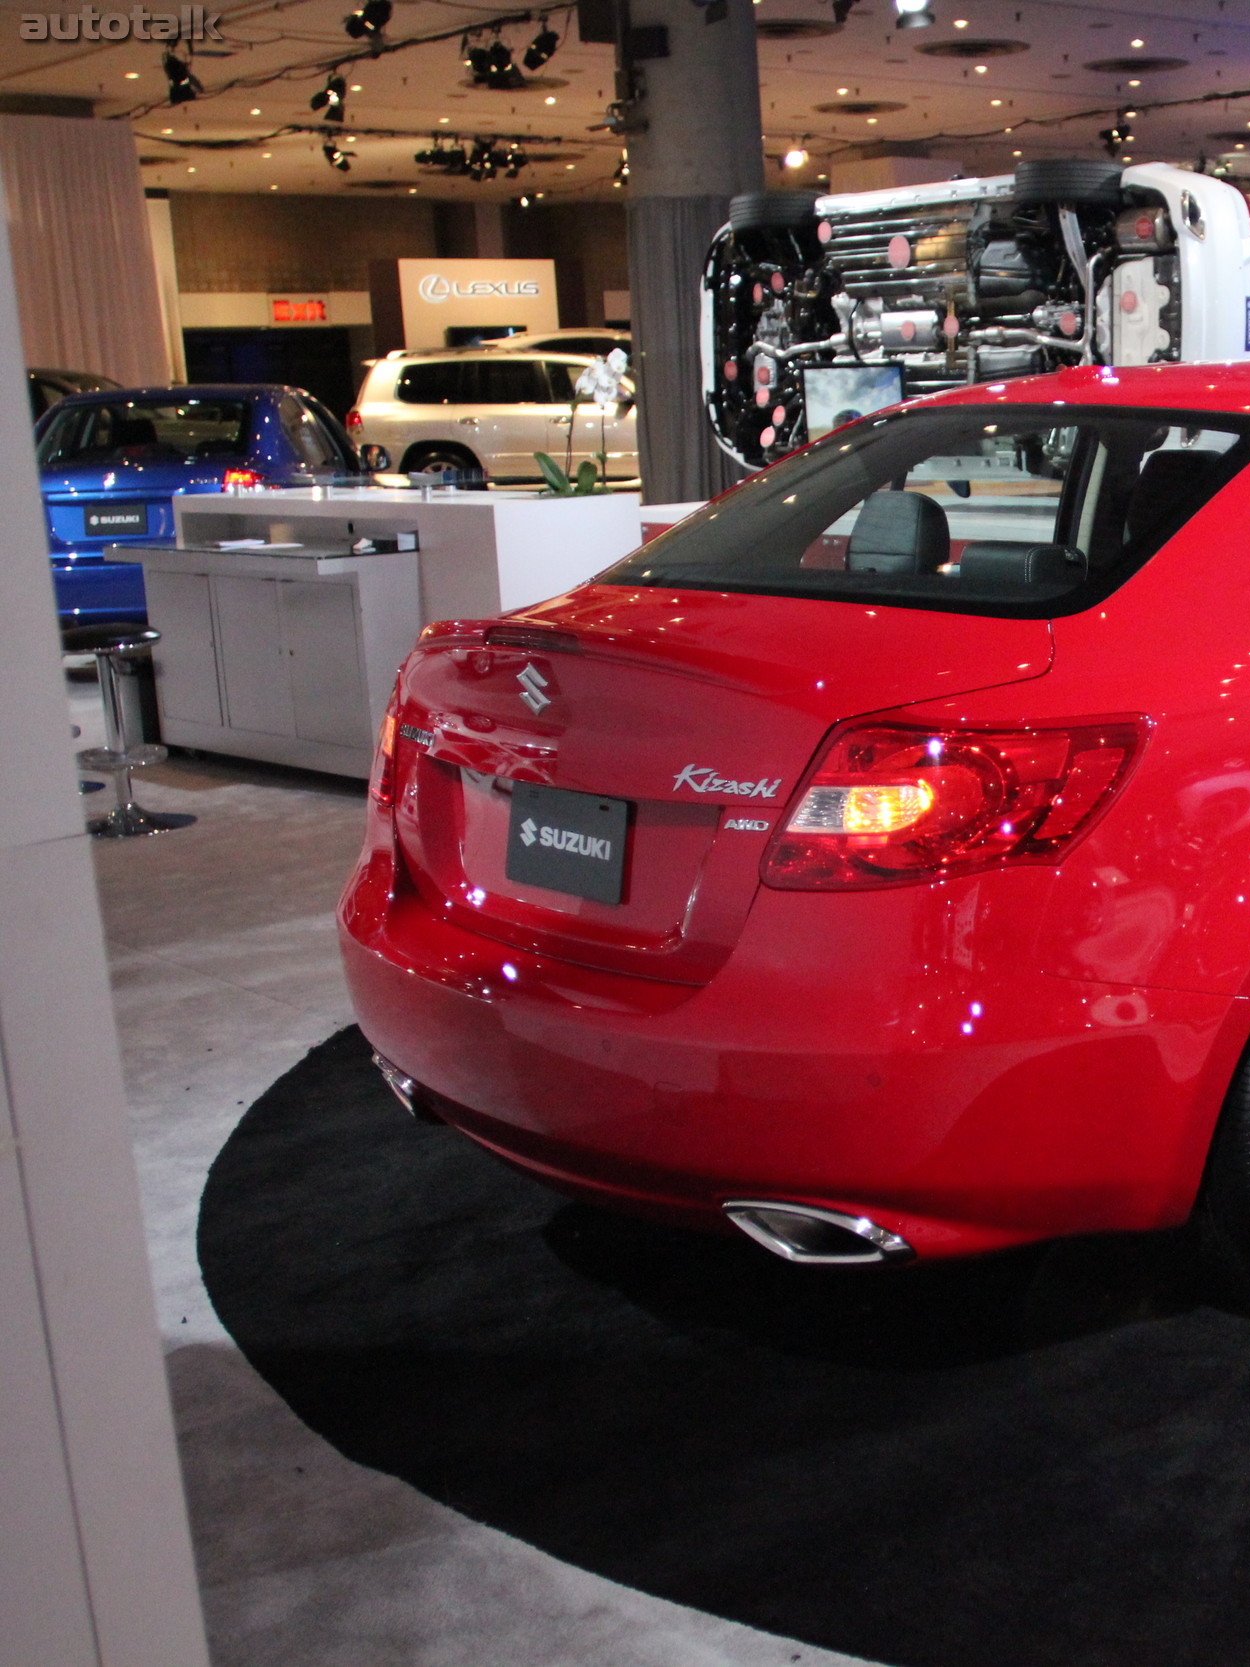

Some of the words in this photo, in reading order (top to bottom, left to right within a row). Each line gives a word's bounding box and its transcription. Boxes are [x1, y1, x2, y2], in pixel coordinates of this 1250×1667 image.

[453, 280, 540, 297] LEXUS
[100, 514, 140, 524] SUZUKI
[672, 763, 782, 798] Kizashi
[723, 818, 770, 831] AWD
[539, 825, 611, 861] SUZUKI
